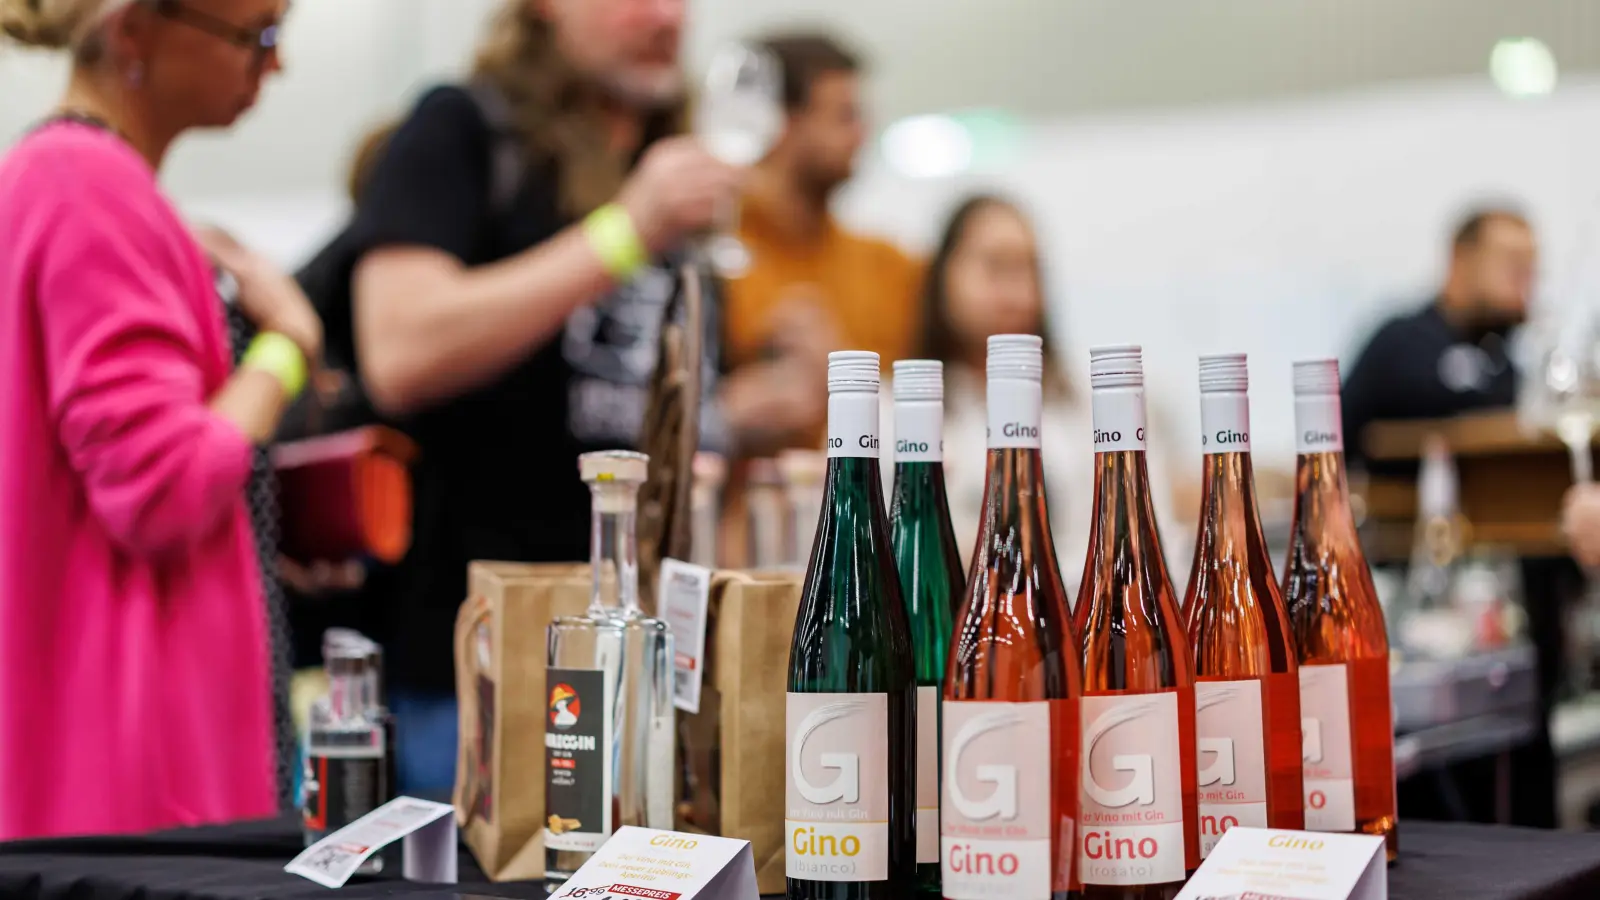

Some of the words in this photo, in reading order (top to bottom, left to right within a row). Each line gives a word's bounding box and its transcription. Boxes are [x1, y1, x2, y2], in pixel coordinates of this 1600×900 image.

[1003, 422, 1038, 439] Gino
[1093, 429, 1121, 444] Gino
[1216, 430, 1249, 444] Gino
[1304, 430, 1337, 445] Gino
[828, 436, 843, 448] no
[858, 434, 879, 448] Gin
[896, 439, 929, 453] Gino
[1226, 790, 1245, 800] Gin
[1094, 812, 1119, 822] Vino
[1122, 812, 1142, 822] mit
[1144, 810, 1164, 820] Gin
[1200, 815, 1239, 836] no
[650, 834, 698, 851] Gino
[793, 826, 861, 857] Gino
[1083, 830, 1158, 860] Gino
[1268, 834, 1325, 851] Gino
[794, 859, 857, 876] (bianco)
[949, 844, 1020, 876] Gino
[1089, 863, 1154, 878] (rosato)
[612, 884, 672, 900] MESSEPREIS
